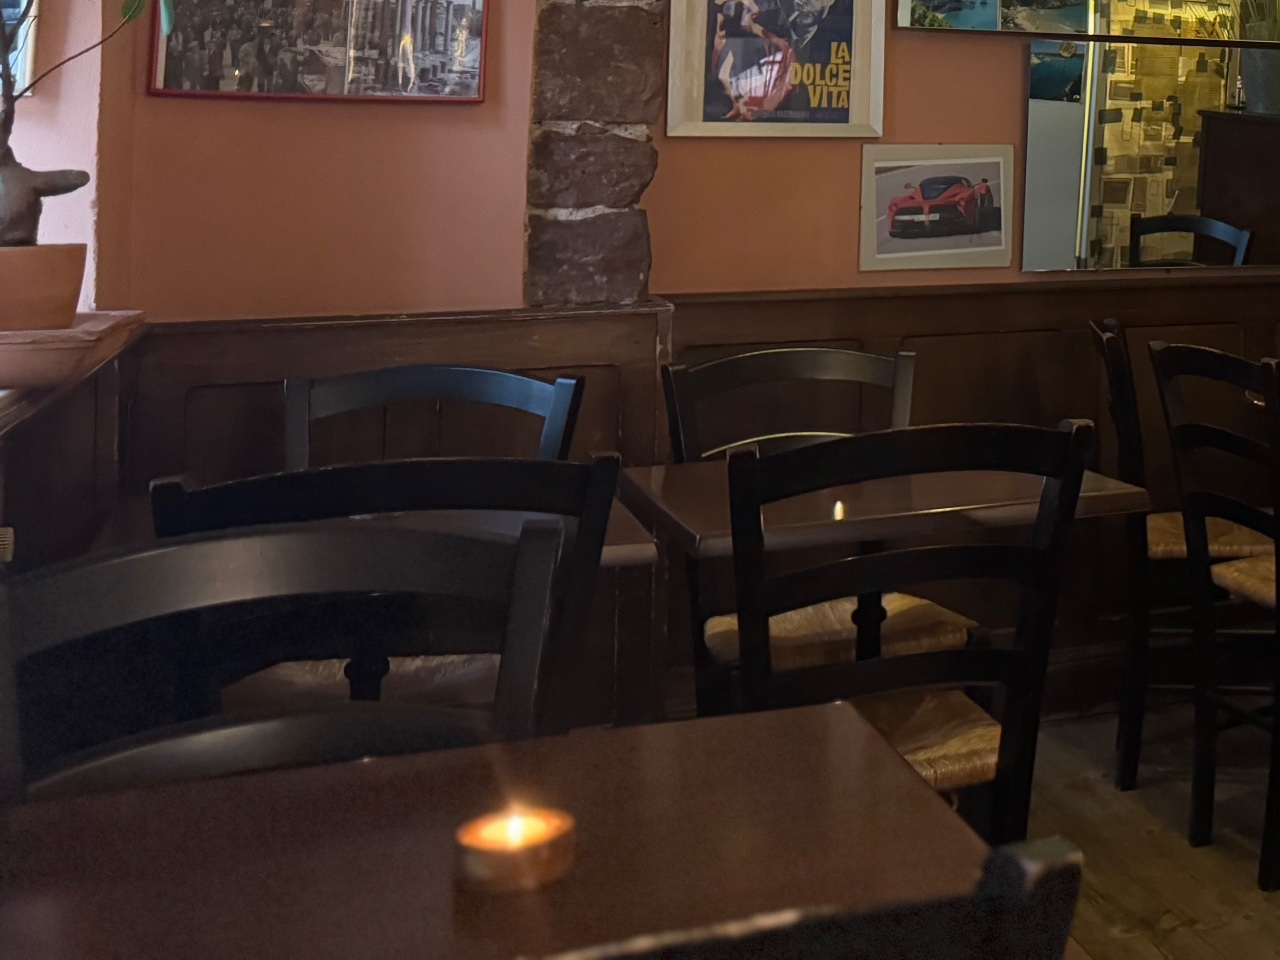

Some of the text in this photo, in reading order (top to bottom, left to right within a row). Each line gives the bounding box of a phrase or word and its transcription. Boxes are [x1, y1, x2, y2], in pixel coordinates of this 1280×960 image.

[831, 42, 850, 64] LA
[790, 62, 850, 86] DOLCE
[808, 86, 849, 108] VITA
